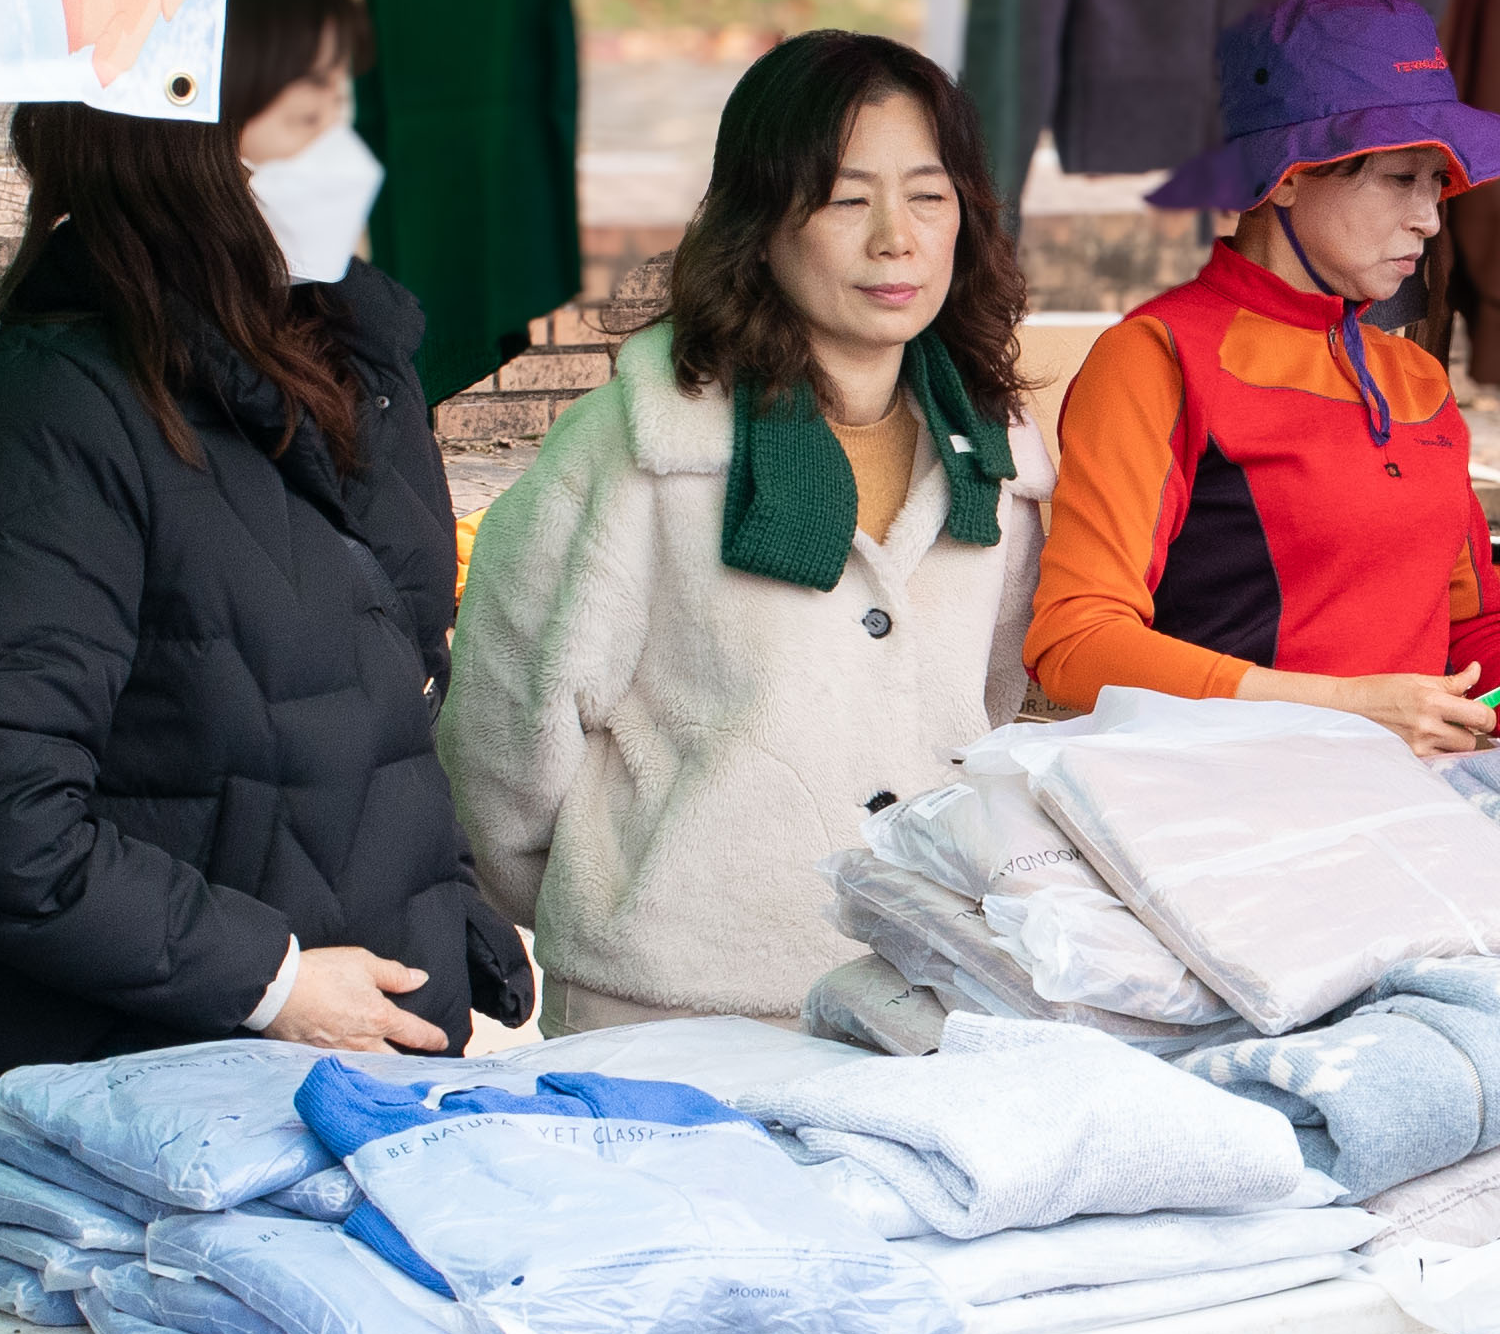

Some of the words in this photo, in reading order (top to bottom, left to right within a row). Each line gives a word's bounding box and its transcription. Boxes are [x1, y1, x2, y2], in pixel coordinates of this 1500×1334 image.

[994, 846, 1085, 880] OONDA
[386, 1141, 413, 1160] BE
[421, 1117, 515, 1147] NATURA
[537, 1125, 580, 1145] YET
